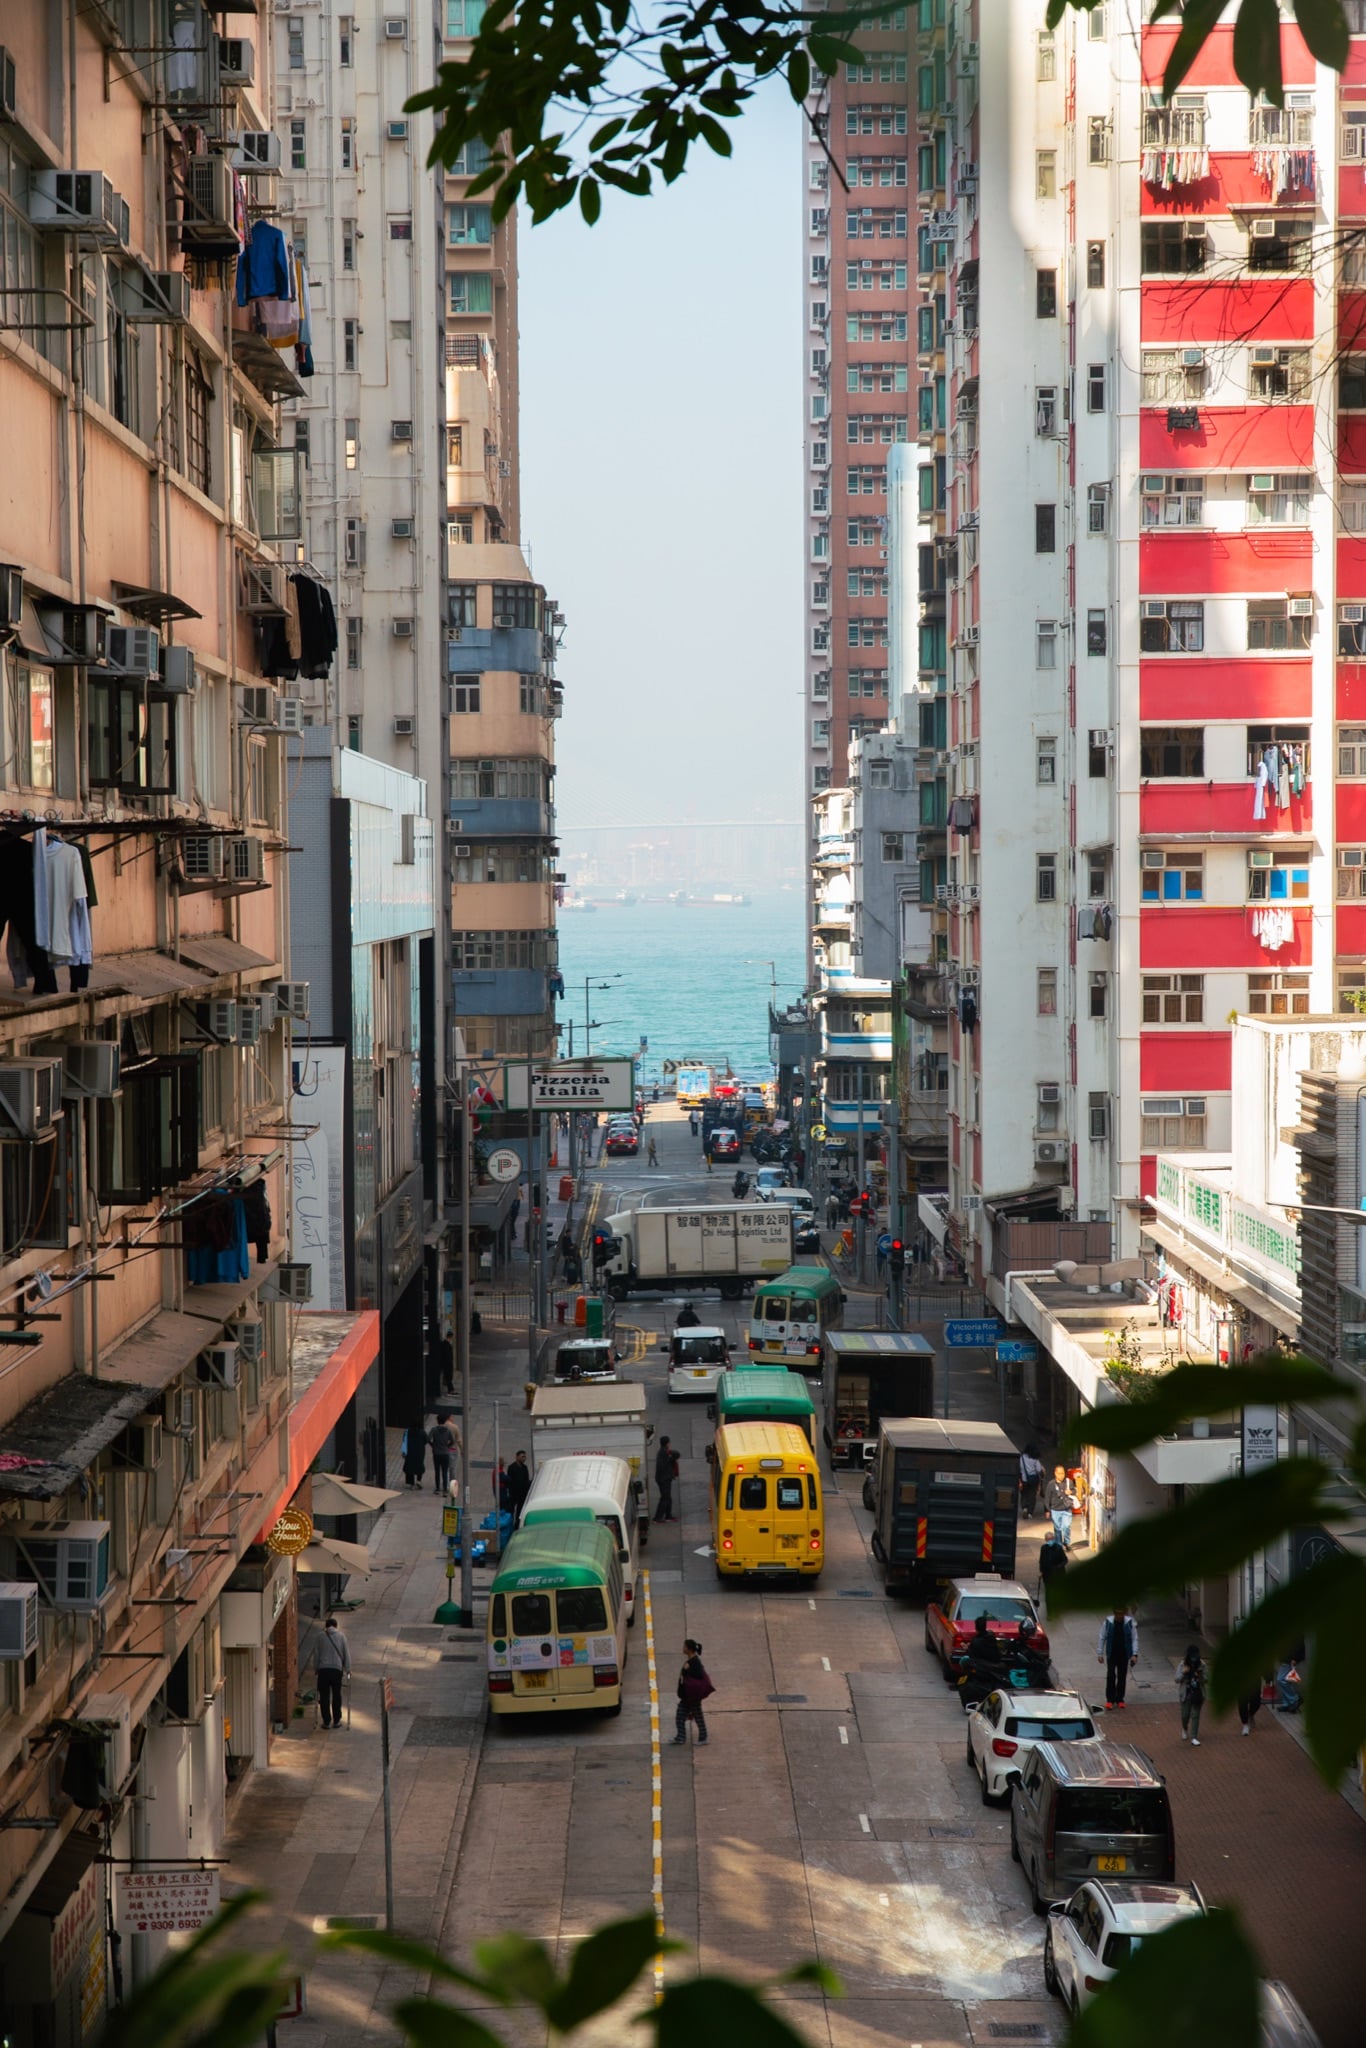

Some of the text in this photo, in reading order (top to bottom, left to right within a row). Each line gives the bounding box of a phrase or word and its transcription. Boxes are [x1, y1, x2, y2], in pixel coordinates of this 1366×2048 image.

[531, 1074, 610, 1085] Pizzeria
[539, 1086, 600, 1096] Italia
[705, 1215, 730, 1227] 物流
[740, 1214, 789, 1226] 有限公司
[295, 1196, 328, 1259] Unit
[702, 1228, 781, 1238] Chi Hung Logistics Ltd
[952, 1323, 981, 1331] Victoria
[273, 1518, 301, 1530] Slow
[273, 1530, 302, 1541] House
[150, 1919, 202, 1930] 9309 6932
